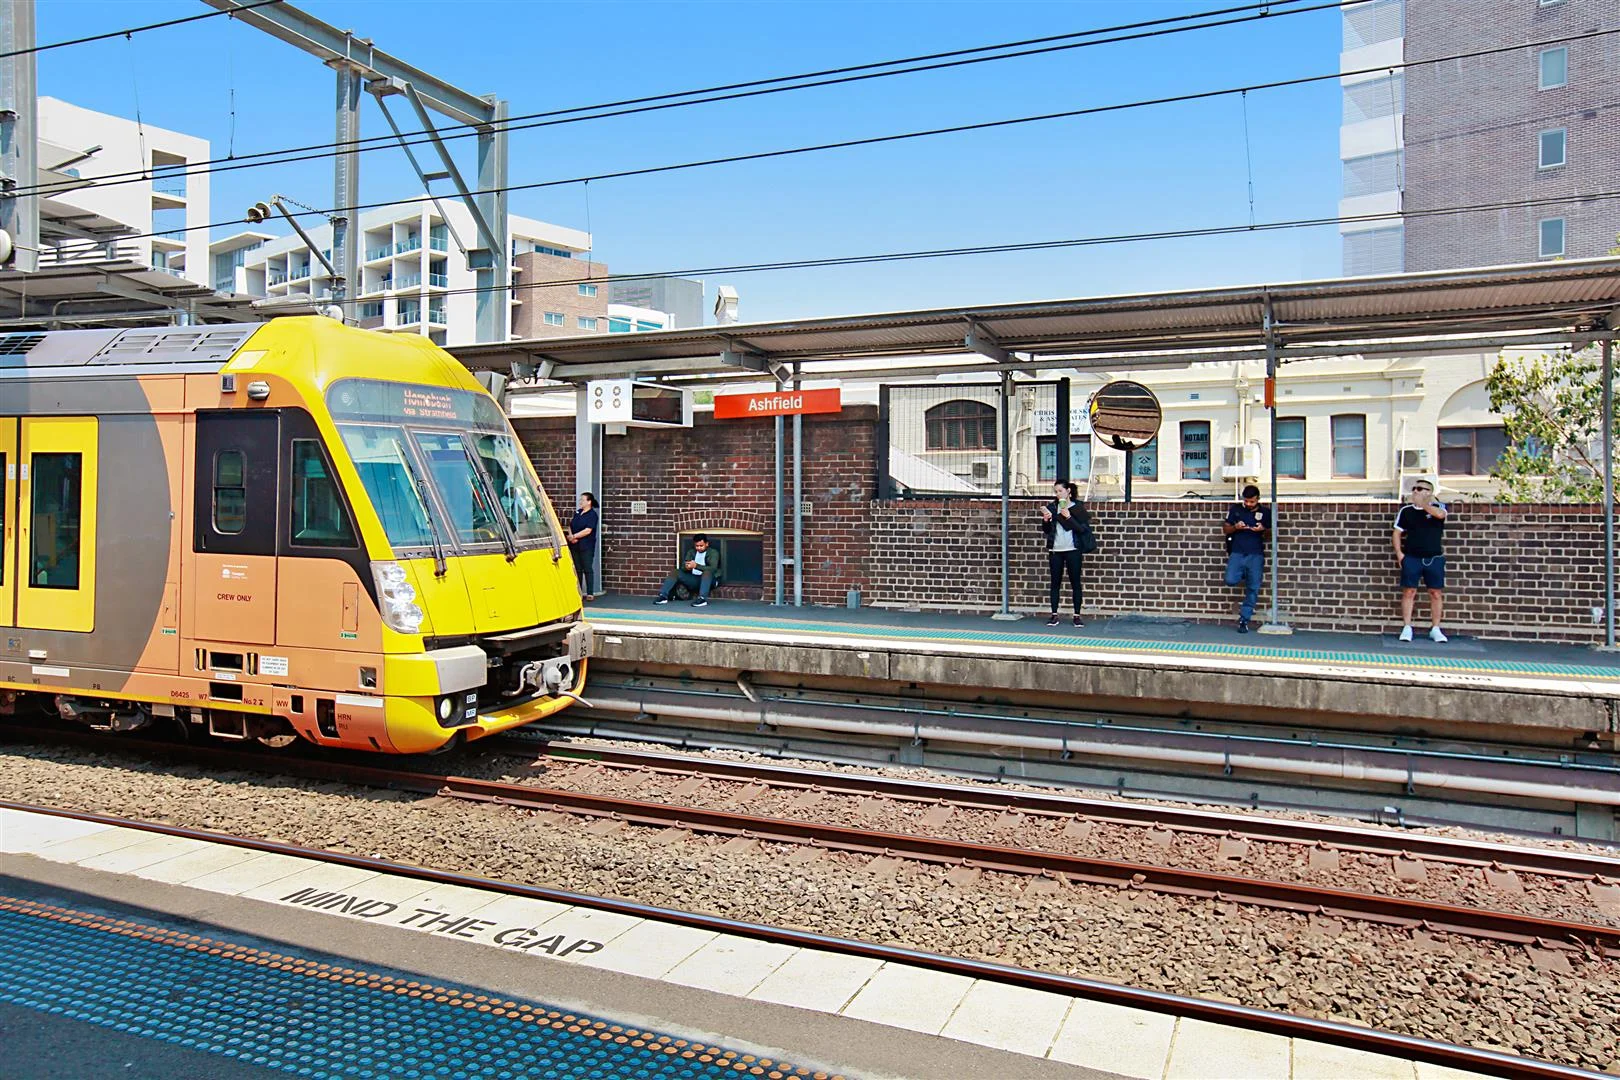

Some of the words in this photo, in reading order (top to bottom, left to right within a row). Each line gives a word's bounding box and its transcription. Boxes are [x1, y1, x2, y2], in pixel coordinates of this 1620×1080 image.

[748, 395, 803, 412] Ashfield
[1184, 433, 1209, 442] NOTARY
[1185, 451, 1208, 460] PUBLIC
[217, 593, 235, 601] CREW
[236, 594, 252, 602] ONLY
[581, 633, 587, 643] A
[580, 646, 587, 657] 25
[276, 700, 289, 708] WW
[337, 713, 352, 721] HRN
[279, 887, 398, 917] MIND
[399, 908, 497, 938] THE
[493, 927, 605, 957] GAP
